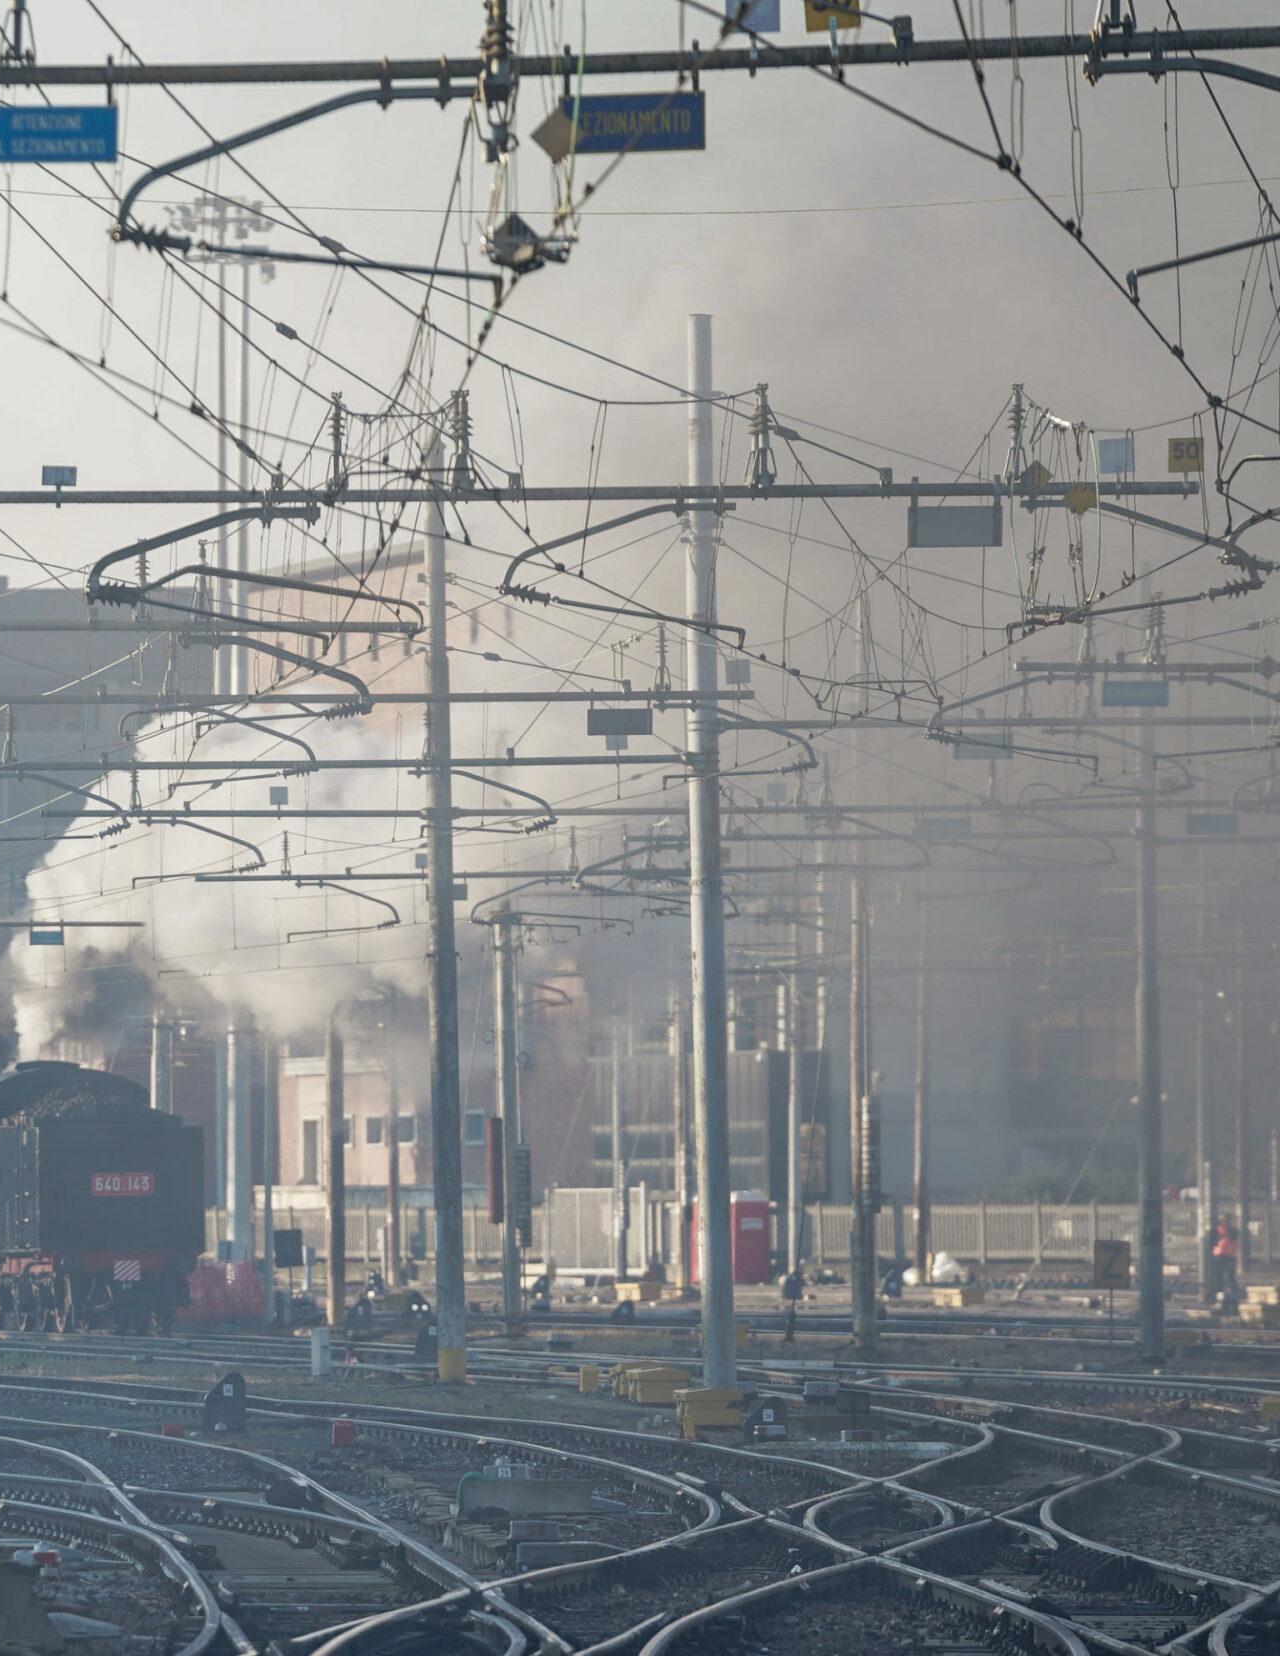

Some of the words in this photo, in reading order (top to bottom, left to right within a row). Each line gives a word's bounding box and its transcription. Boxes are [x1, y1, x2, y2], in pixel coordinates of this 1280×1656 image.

[11, 113, 83, 130] ATTENZIONE
[11, 137, 106, 155] SEZIONAMENTO
[1173, 441, 1199, 460] 50
[1103, 1243, 1122, 1279] Z
